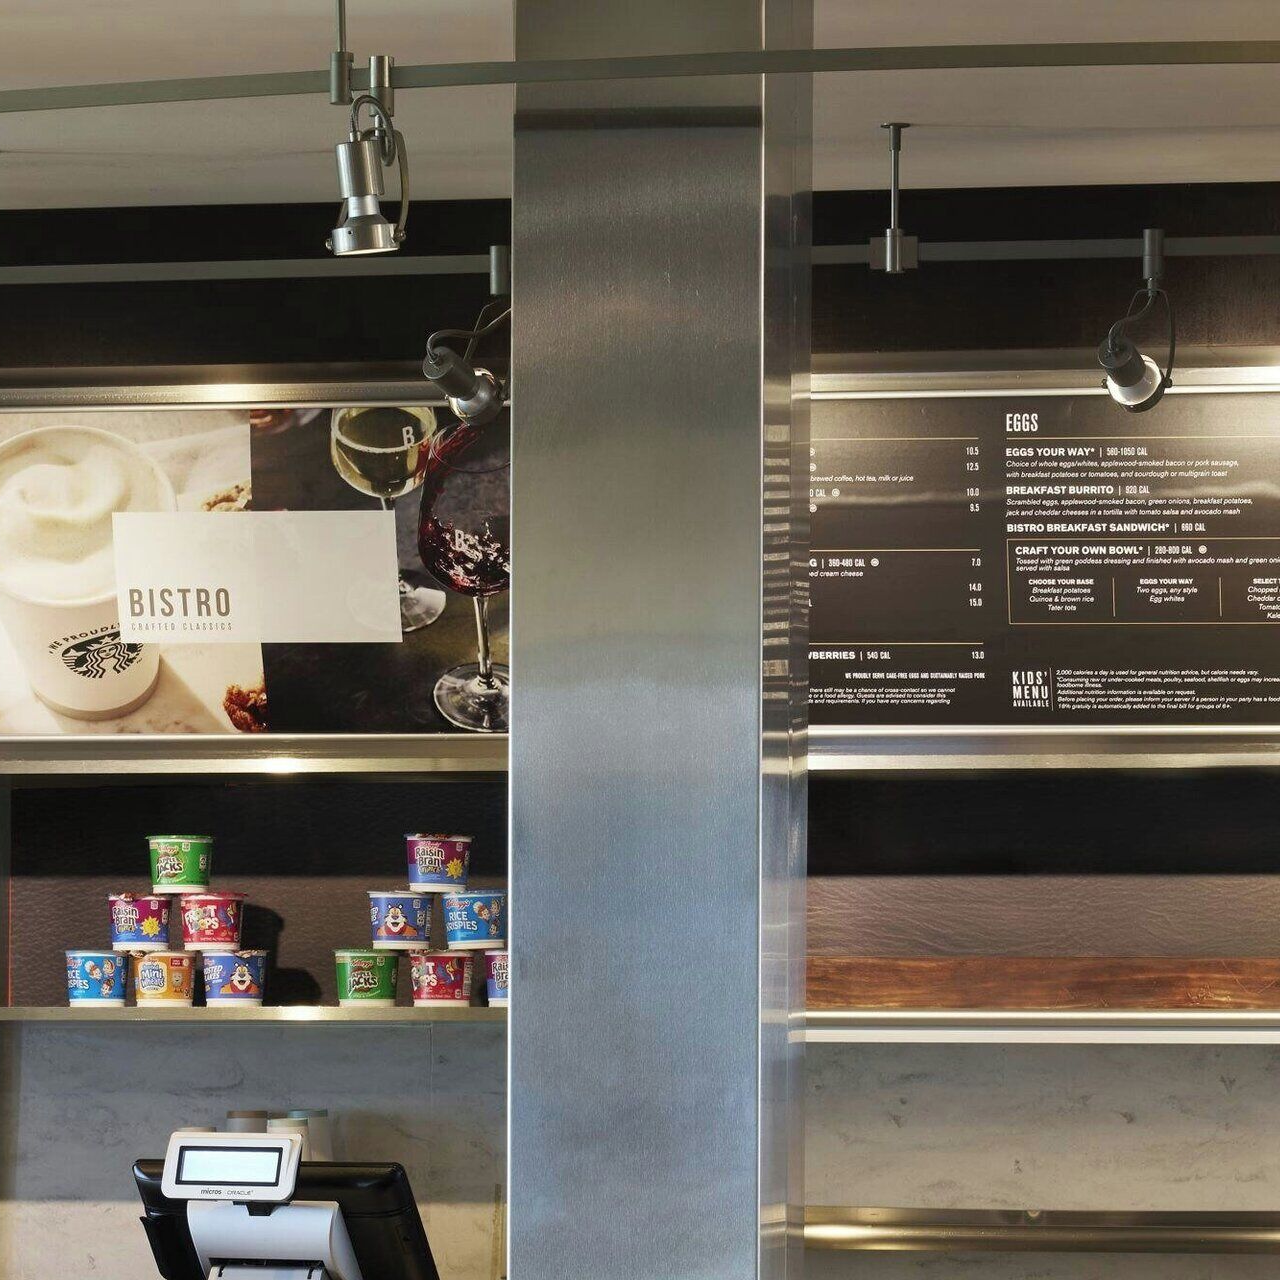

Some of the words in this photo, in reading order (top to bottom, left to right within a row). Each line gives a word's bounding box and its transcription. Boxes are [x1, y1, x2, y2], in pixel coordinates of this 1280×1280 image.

[1006, 413, 1038, 432] EGGS
[1006, 448, 1034, 456] EGGS
[1036, 448, 1064, 456] YOUR
[966, 462, 979, 471] 12.5
[1006, 486, 1067, 495] BREAKFAST
[1069, 485, 1114, 494] BURRITO
[970, 504, 980, 512] 9.5
[1006, 524, 1045, 532] BISTRO
[1046, 523, 1107, 532] BREAKFAST
[1015, 546, 1048, 555] CRAFT
[1050, 546, 1079, 555] YOUR
[1081, 546, 1107, 554] OWN
[129, 588, 231, 617] BISTRO
[131, 623, 176, 631] CRAFTED
[183, 623, 233, 631] CLASSICS
[1012, 671, 1048, 685] KIDS'
[1012, 686, 1049, 699] MENU
[415, 847, 444, 859] Raisin
[418, 857, 441, 866] Bran
[449, 912, 467, 921] RICE
